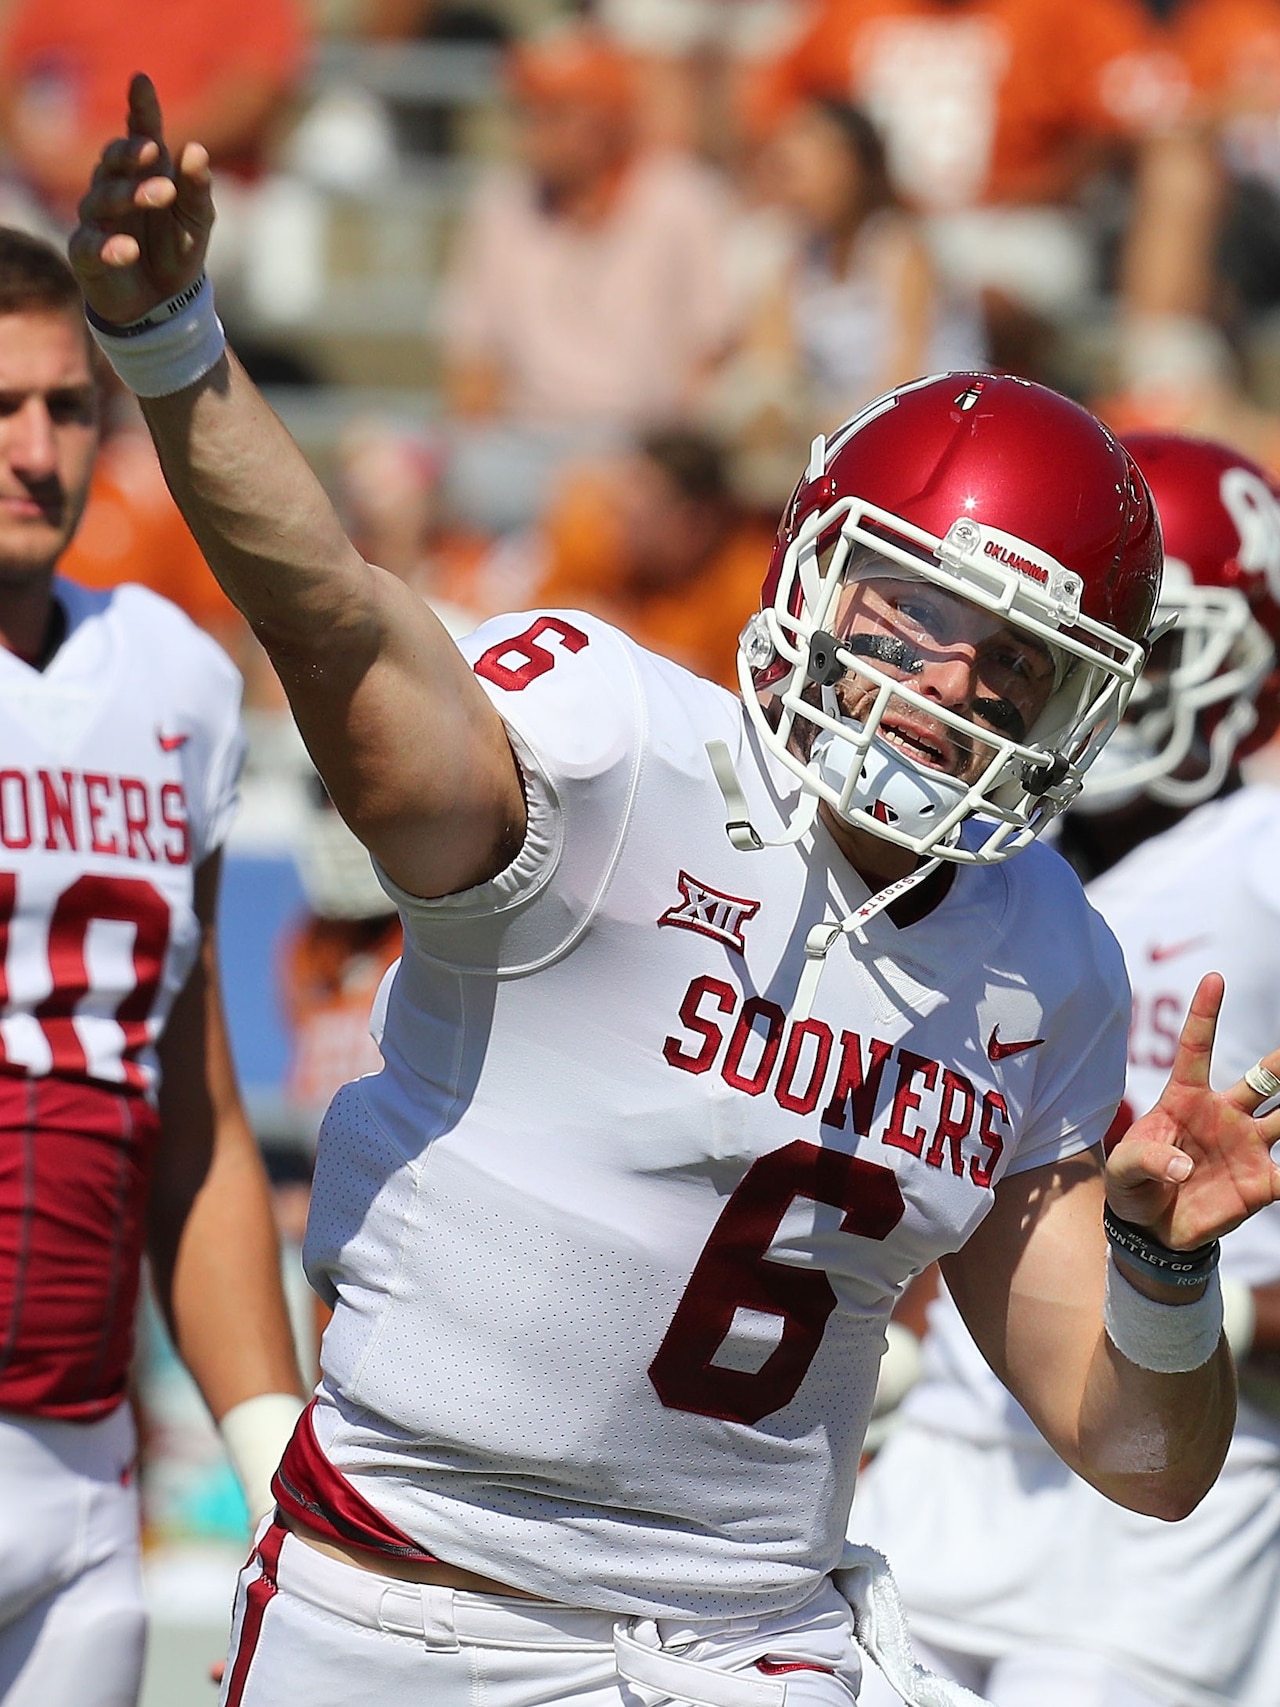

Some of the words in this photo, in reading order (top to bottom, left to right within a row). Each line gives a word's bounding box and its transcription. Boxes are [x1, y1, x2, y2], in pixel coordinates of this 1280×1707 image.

[983, 540, 1050, 587] OKLAHOMA
[473, 616, 589, 691] 6
[662, 974, 1011, 1189] SOONERS
[647, 1138, 906, 1426] 6
[1139, 1249, 1169, 1267] LET
[1170, 1262, 1193, 1272] GO
